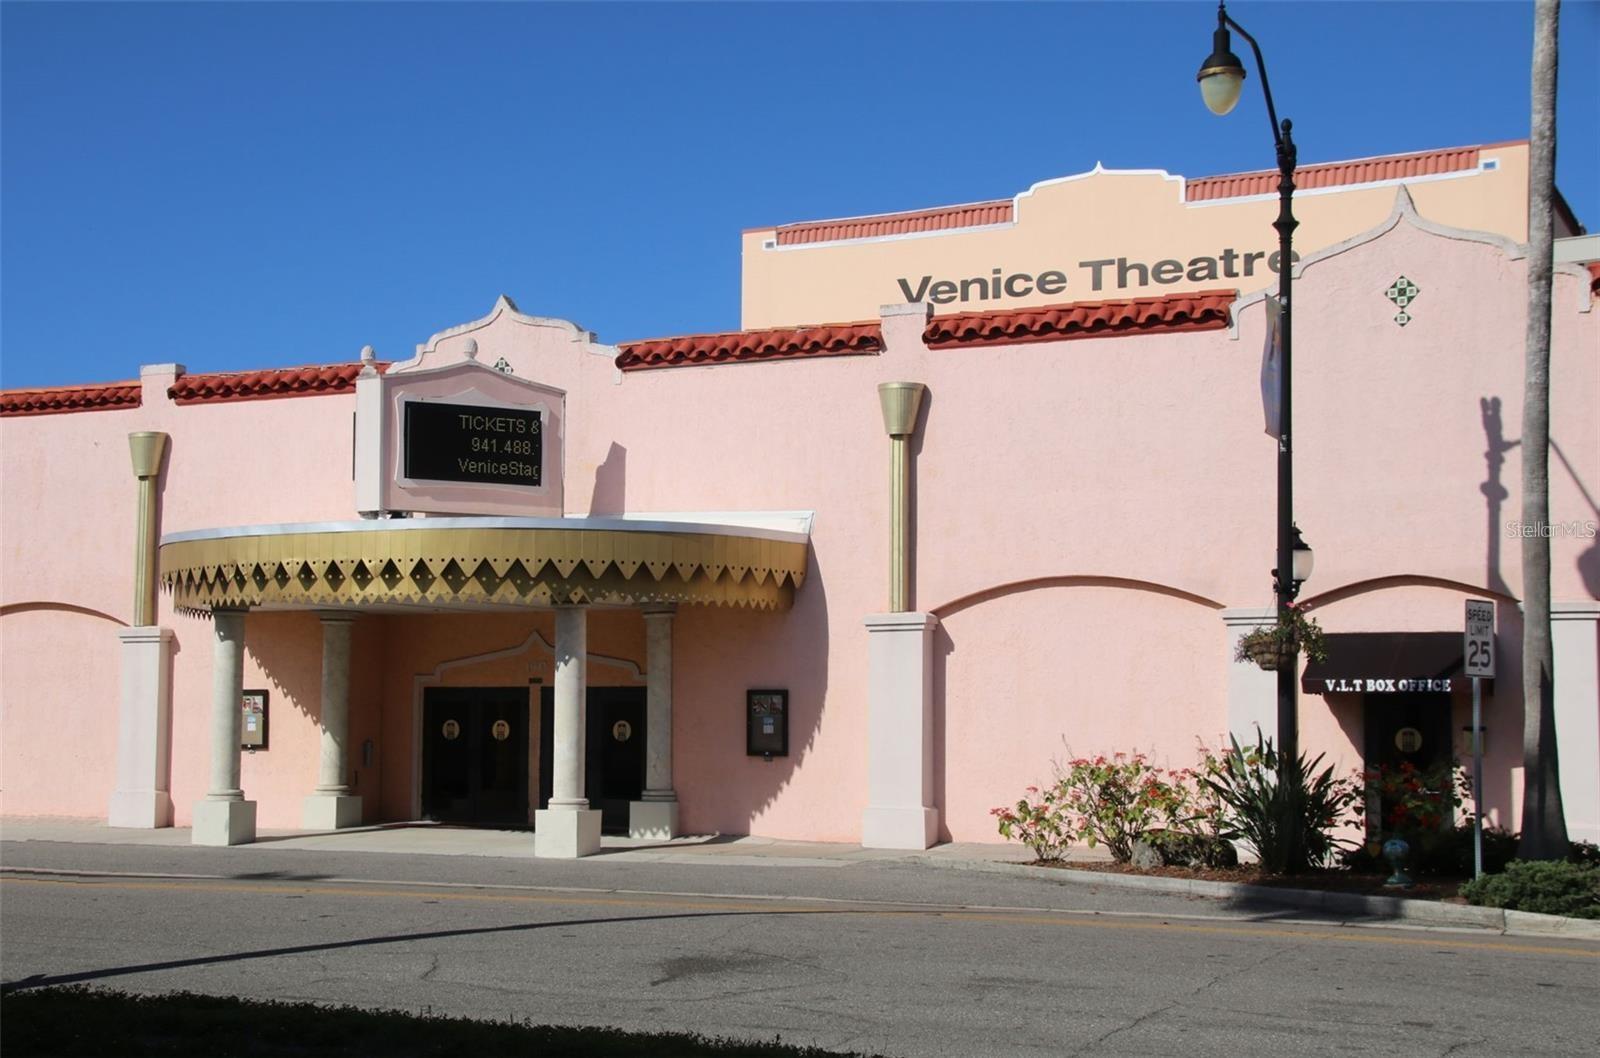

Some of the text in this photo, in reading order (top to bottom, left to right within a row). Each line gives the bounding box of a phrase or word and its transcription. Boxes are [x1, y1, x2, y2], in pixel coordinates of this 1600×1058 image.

[897, 247, 1301, 305] Venice Theatre
[458, 414, 540, 435] TICKETS &
[471, 437, 539, 456] 941.488.
[1467, 608, 1492, 623] SPEED
[1470, 625, 1489, 637] LIMIT
[1468, 640, 1491, 668] 25
[1366, 679, 1396, 692] BOX
[1398, 679, 1451, 692] OFFICE
